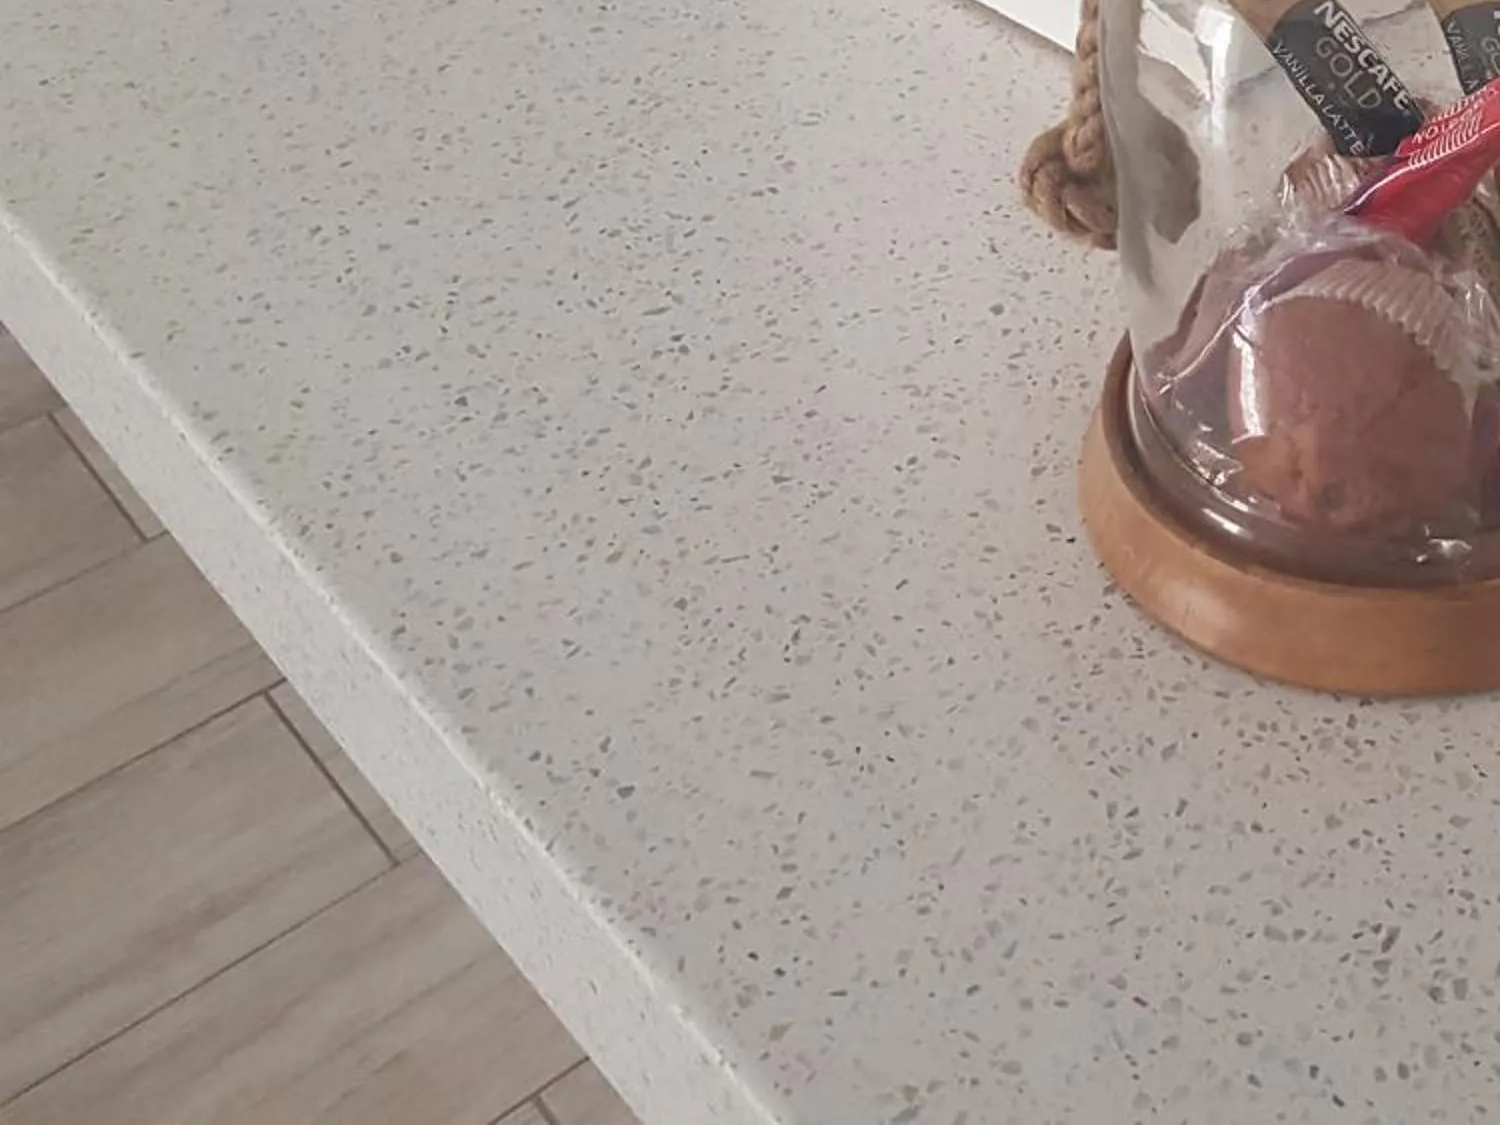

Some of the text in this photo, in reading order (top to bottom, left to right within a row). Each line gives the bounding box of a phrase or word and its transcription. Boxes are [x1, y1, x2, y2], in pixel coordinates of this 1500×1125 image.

[1272, 40, 1365, 155] VANILLA LATTE
[1316, 36, 1382, 109] GOLD
